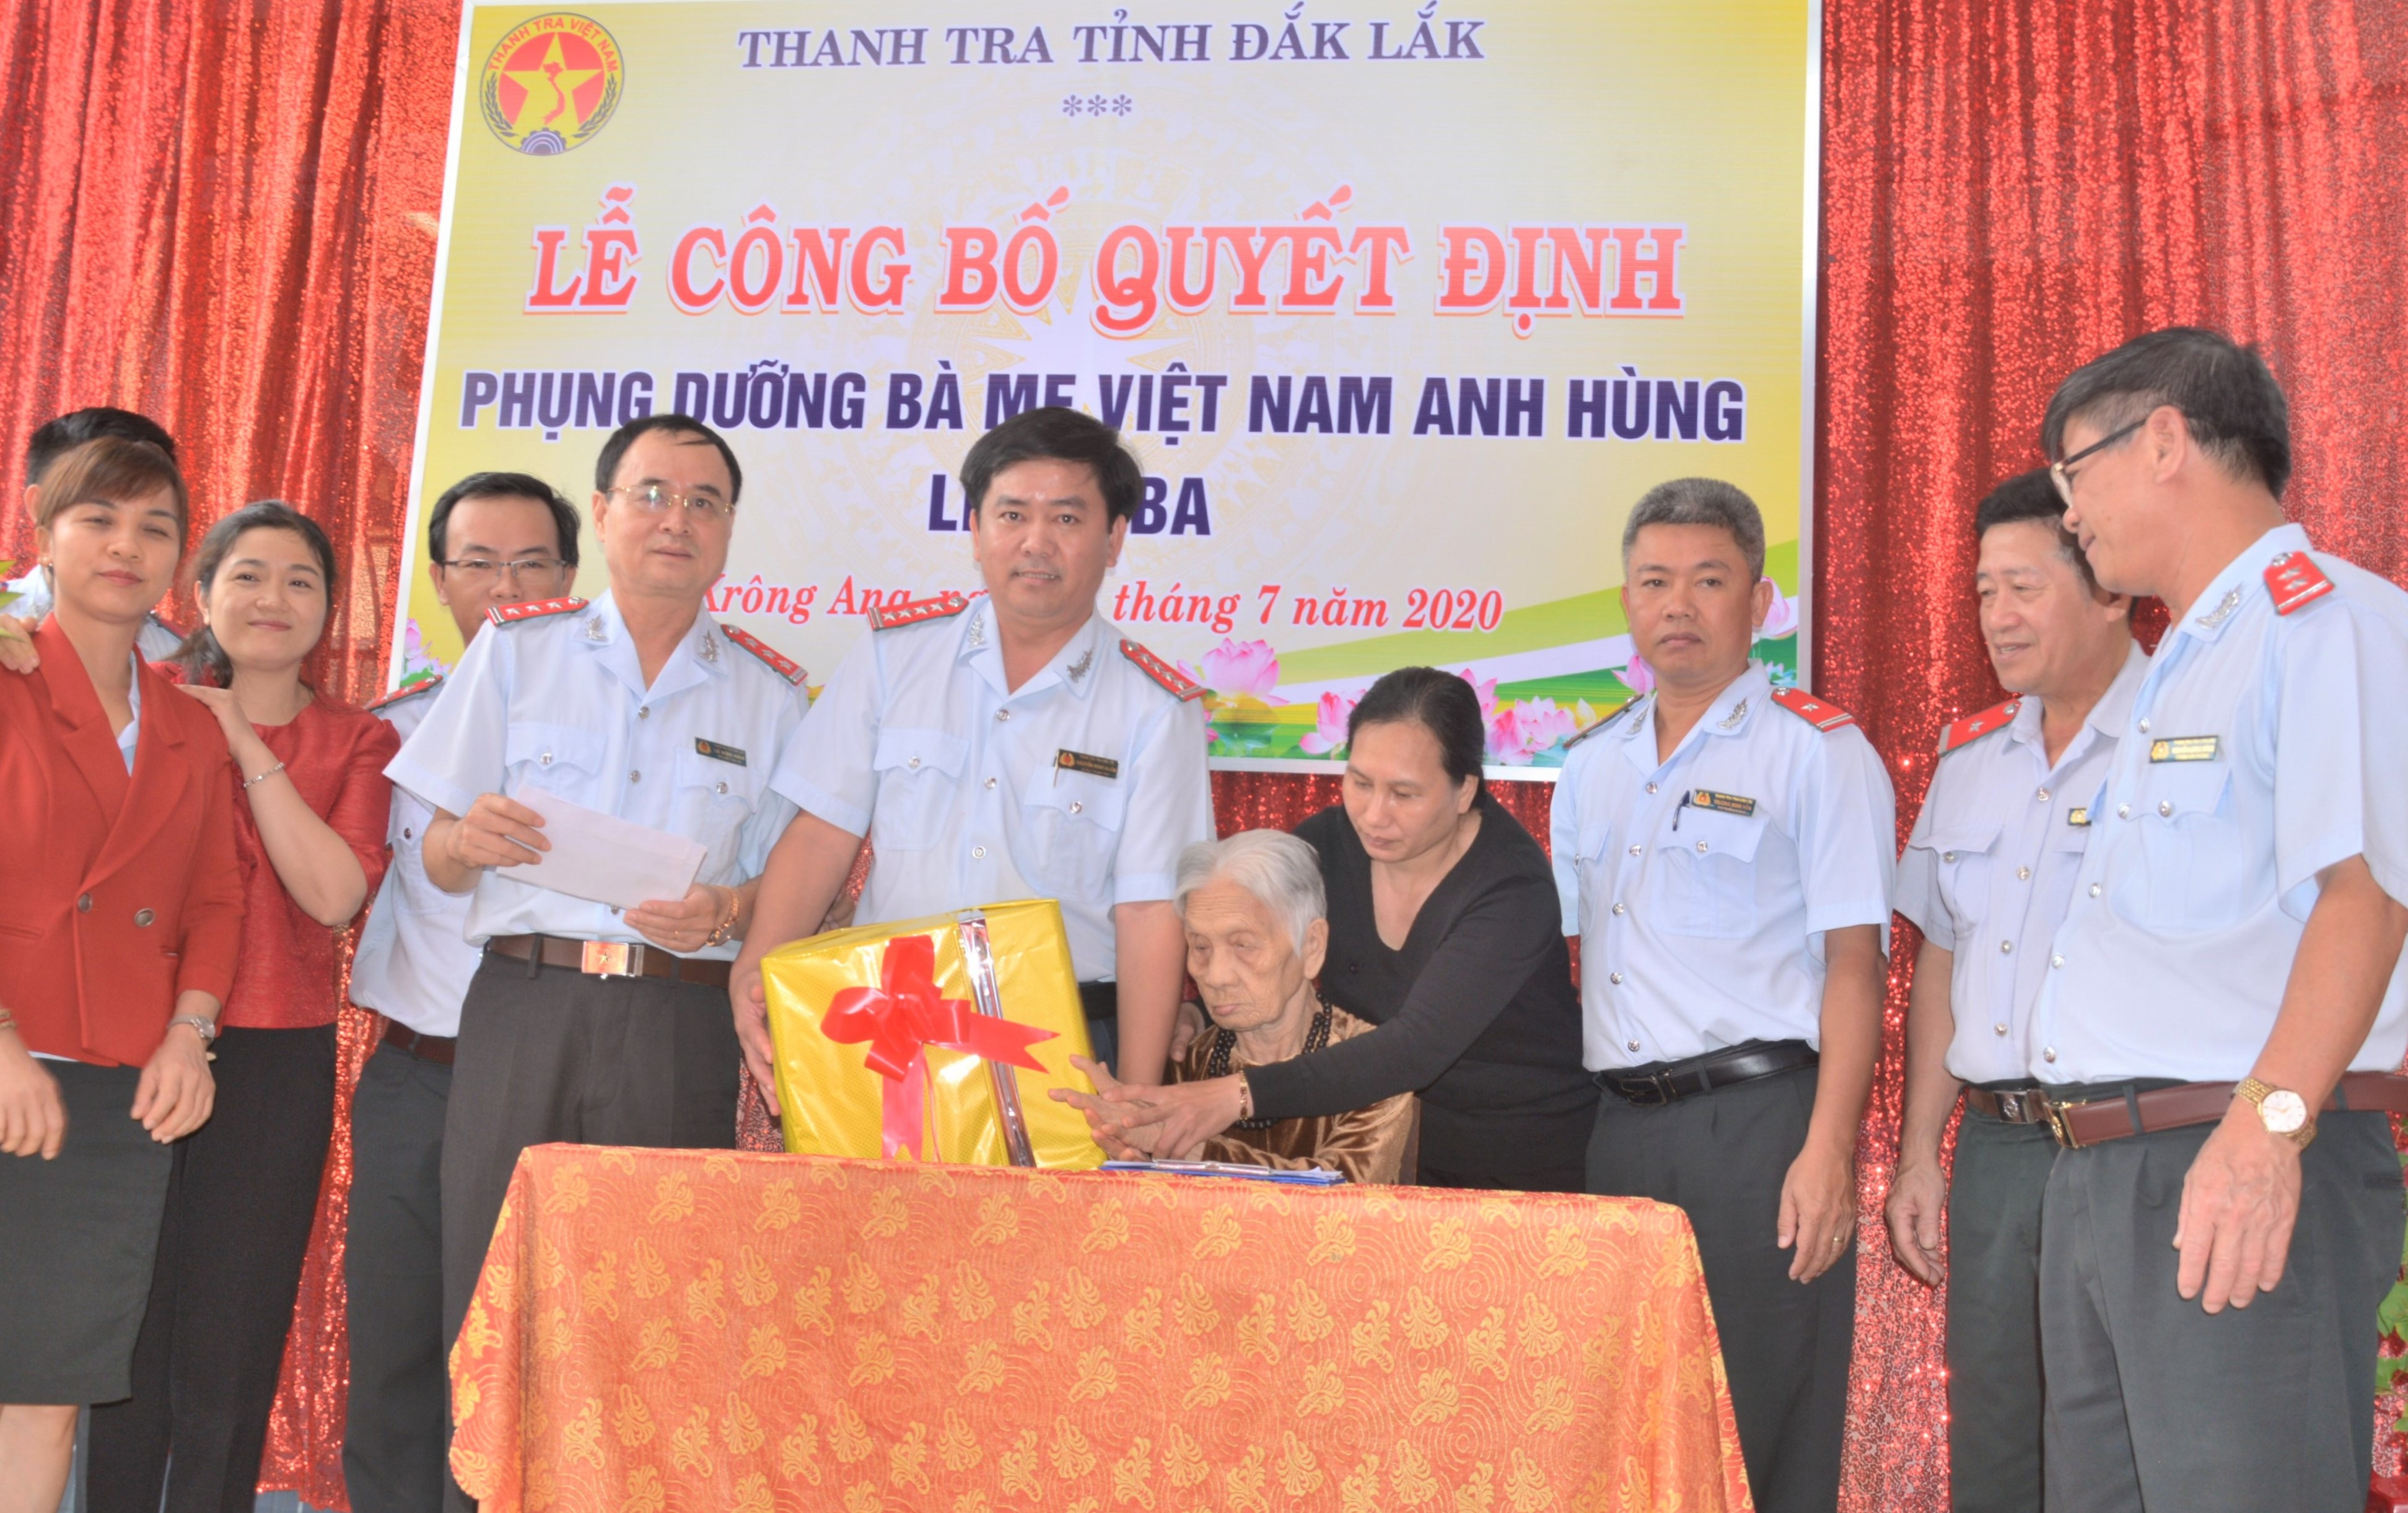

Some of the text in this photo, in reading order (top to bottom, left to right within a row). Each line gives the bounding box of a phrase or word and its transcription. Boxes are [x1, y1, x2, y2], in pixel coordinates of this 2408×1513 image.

[488, 17, 619, 72] THANH TRA VIỆT NAM
[738, 0, 1485, 68] THANH TRA TỈNH ĐẮK LẮK
[527, 184, 1685, 335] LỄ CÔNG BỐ QUYẾT ĐỊNH
[462, 371, 654, 441] PHỤNG
[673, 360, 866, 429] DƯỠNG
[886, 360, 963, 429] BÀ
[1098, 362, 1227, 445] VIỆT
[1248, 375, 1393, 434] NAM
[1412, 377, 1545, 437] ANH
[1567, 366, 1744, 442] HÙNG
[1131, 476, 1212, 535] BA
[1113, 581, 1241, 634] tháng
[1257, 585, 1281, 625] 7
[1292, 587, 1389, 627] năm
[1401, 588, 1504, 631] 2020
